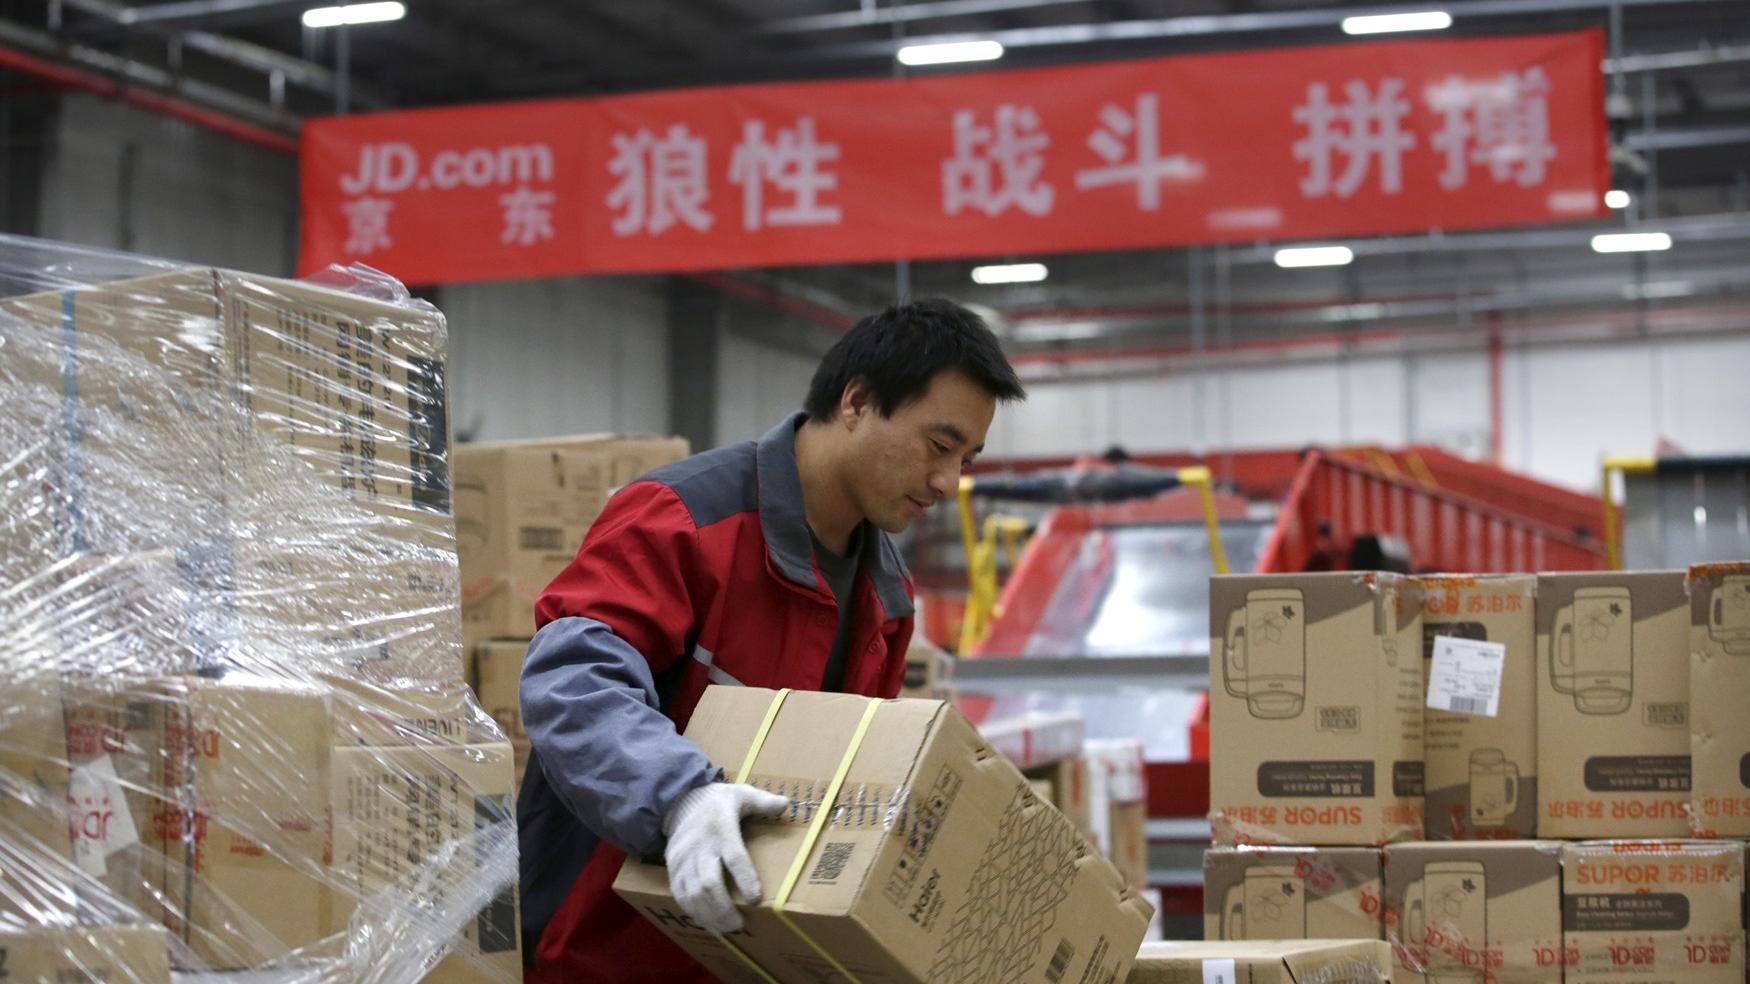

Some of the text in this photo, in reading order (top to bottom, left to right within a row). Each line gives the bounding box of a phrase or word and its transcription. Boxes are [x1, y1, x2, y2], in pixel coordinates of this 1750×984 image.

[606, 67, 1556, 236] 狼性 战斗 拼搏
[340, 142, 554, 194] JD.com
[1284, 806, 1362, 826] SUPOR
[1611, 800, 1689, 820] SUPOR
[1576, 864, 1730, 885] SUPOR 苏泊尔
